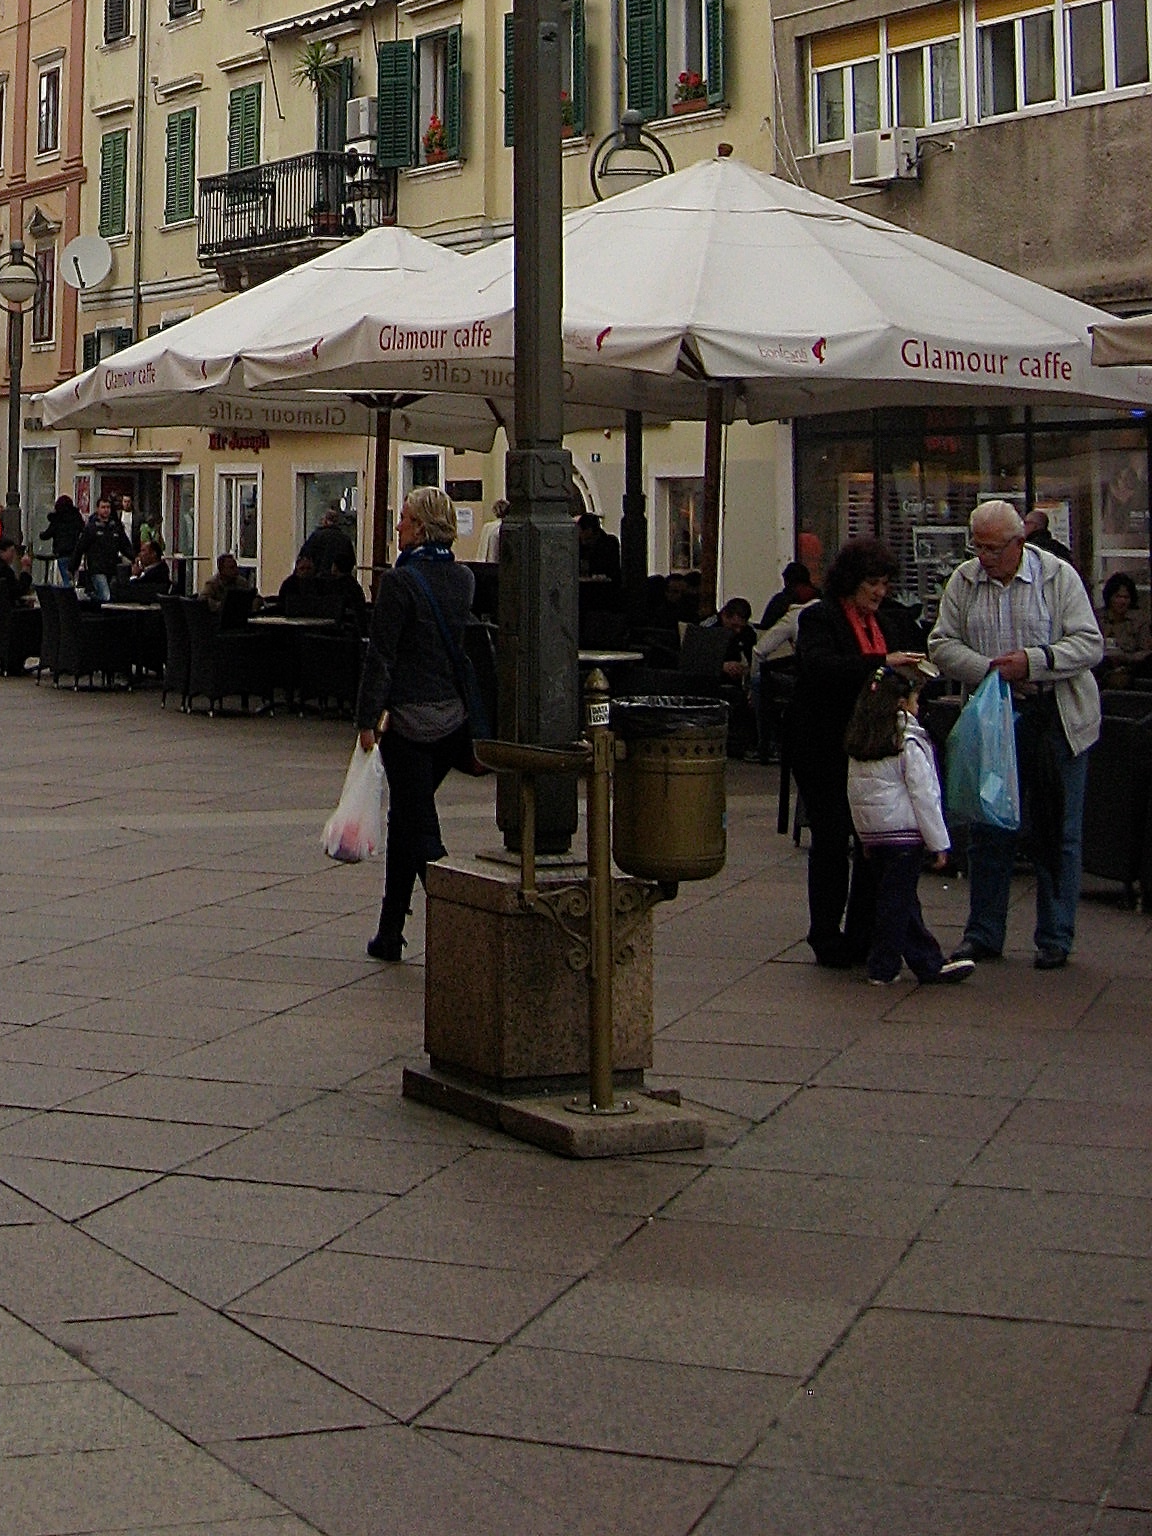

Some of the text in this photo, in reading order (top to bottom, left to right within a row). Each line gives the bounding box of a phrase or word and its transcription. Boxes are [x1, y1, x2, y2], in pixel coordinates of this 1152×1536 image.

[379, 320, 492, 352] Glamour caffe
[105, 361, 156, 390] Glamour caffe
[901, 338, 1073, 381] Glamour caffe
